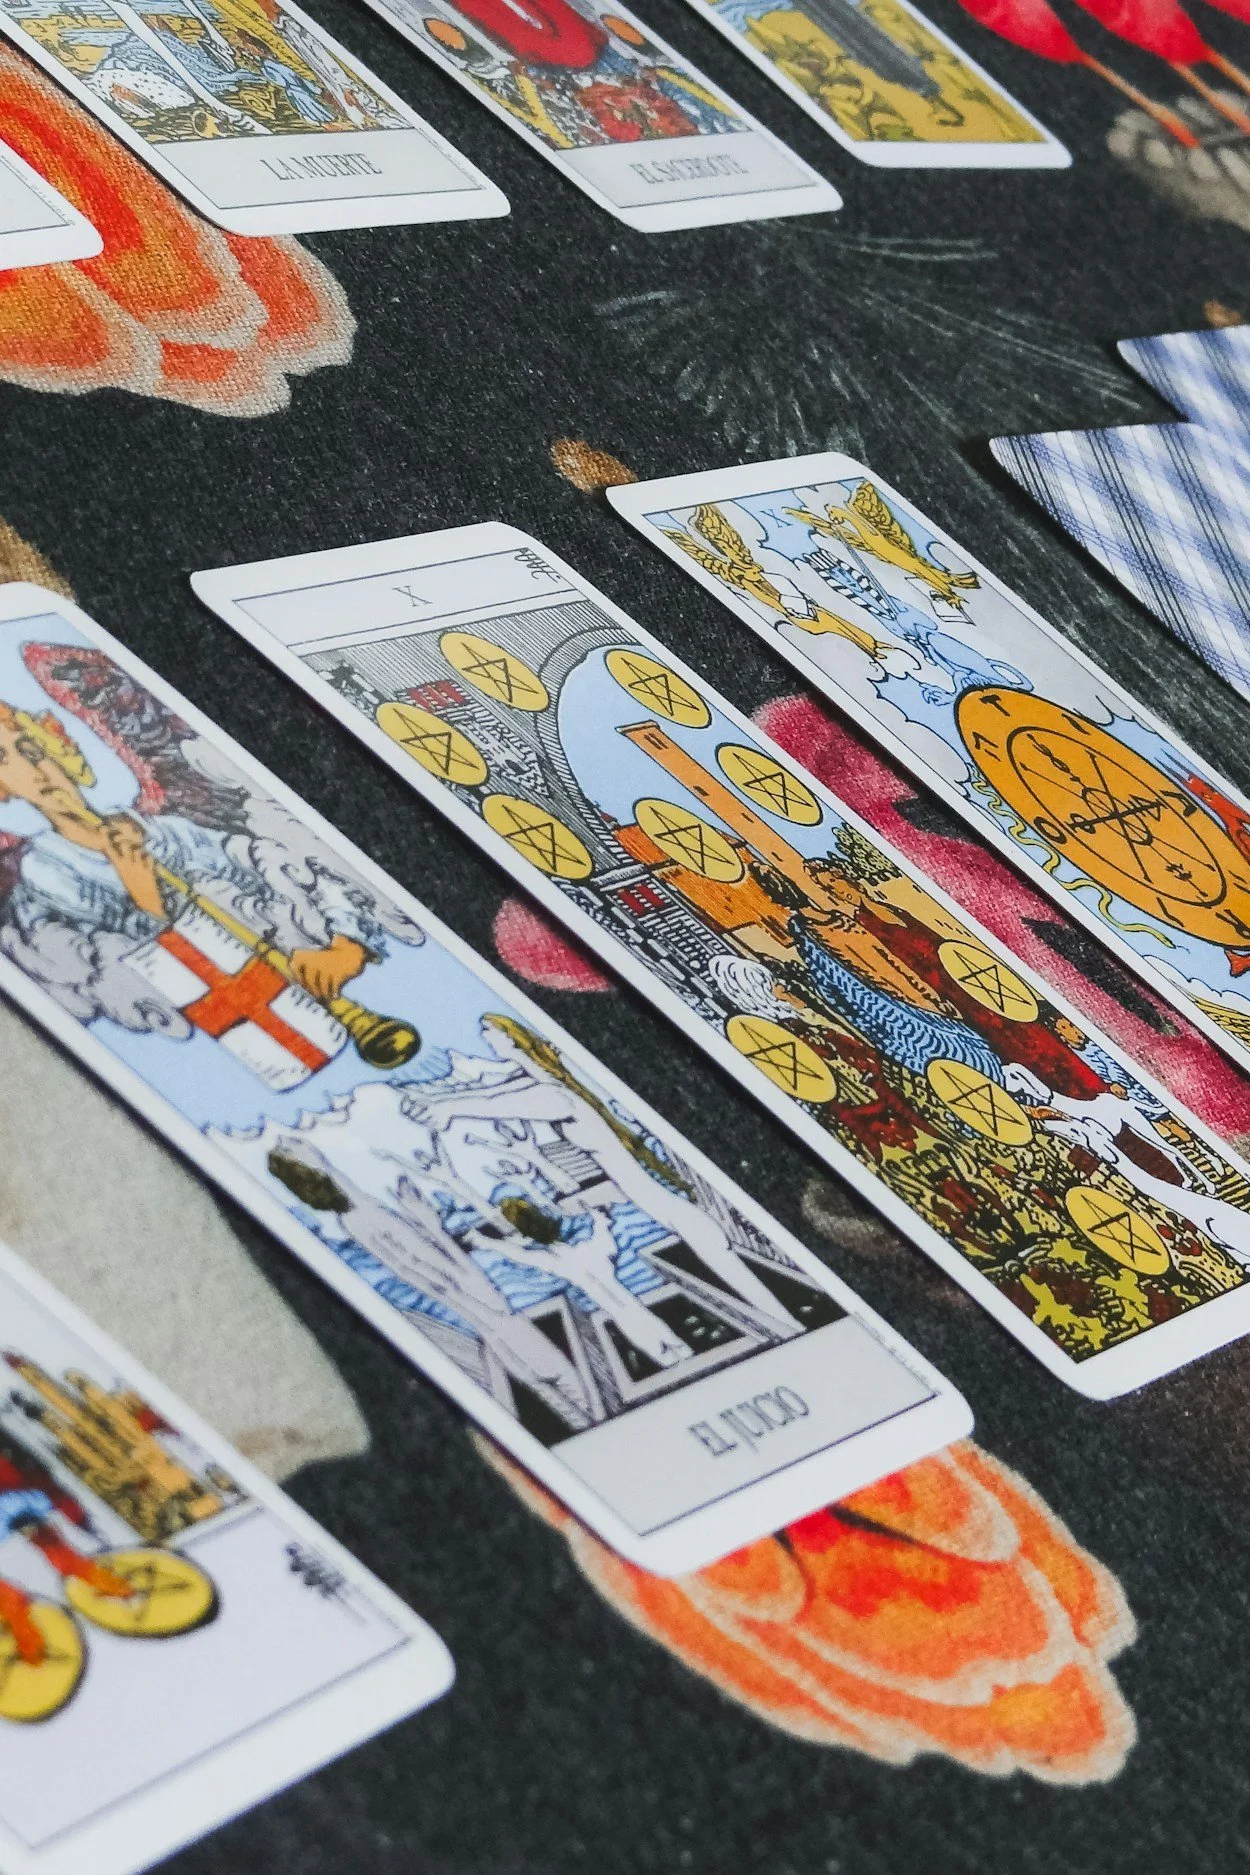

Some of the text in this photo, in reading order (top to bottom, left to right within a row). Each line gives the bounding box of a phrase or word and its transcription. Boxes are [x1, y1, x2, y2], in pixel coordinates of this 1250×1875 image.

[260, 152, 383, 180] LA MUERTE
[758, 508, 793, 528] X
[391, 585, 433, 607] X
[687, 1420, 738, 1456] EL
